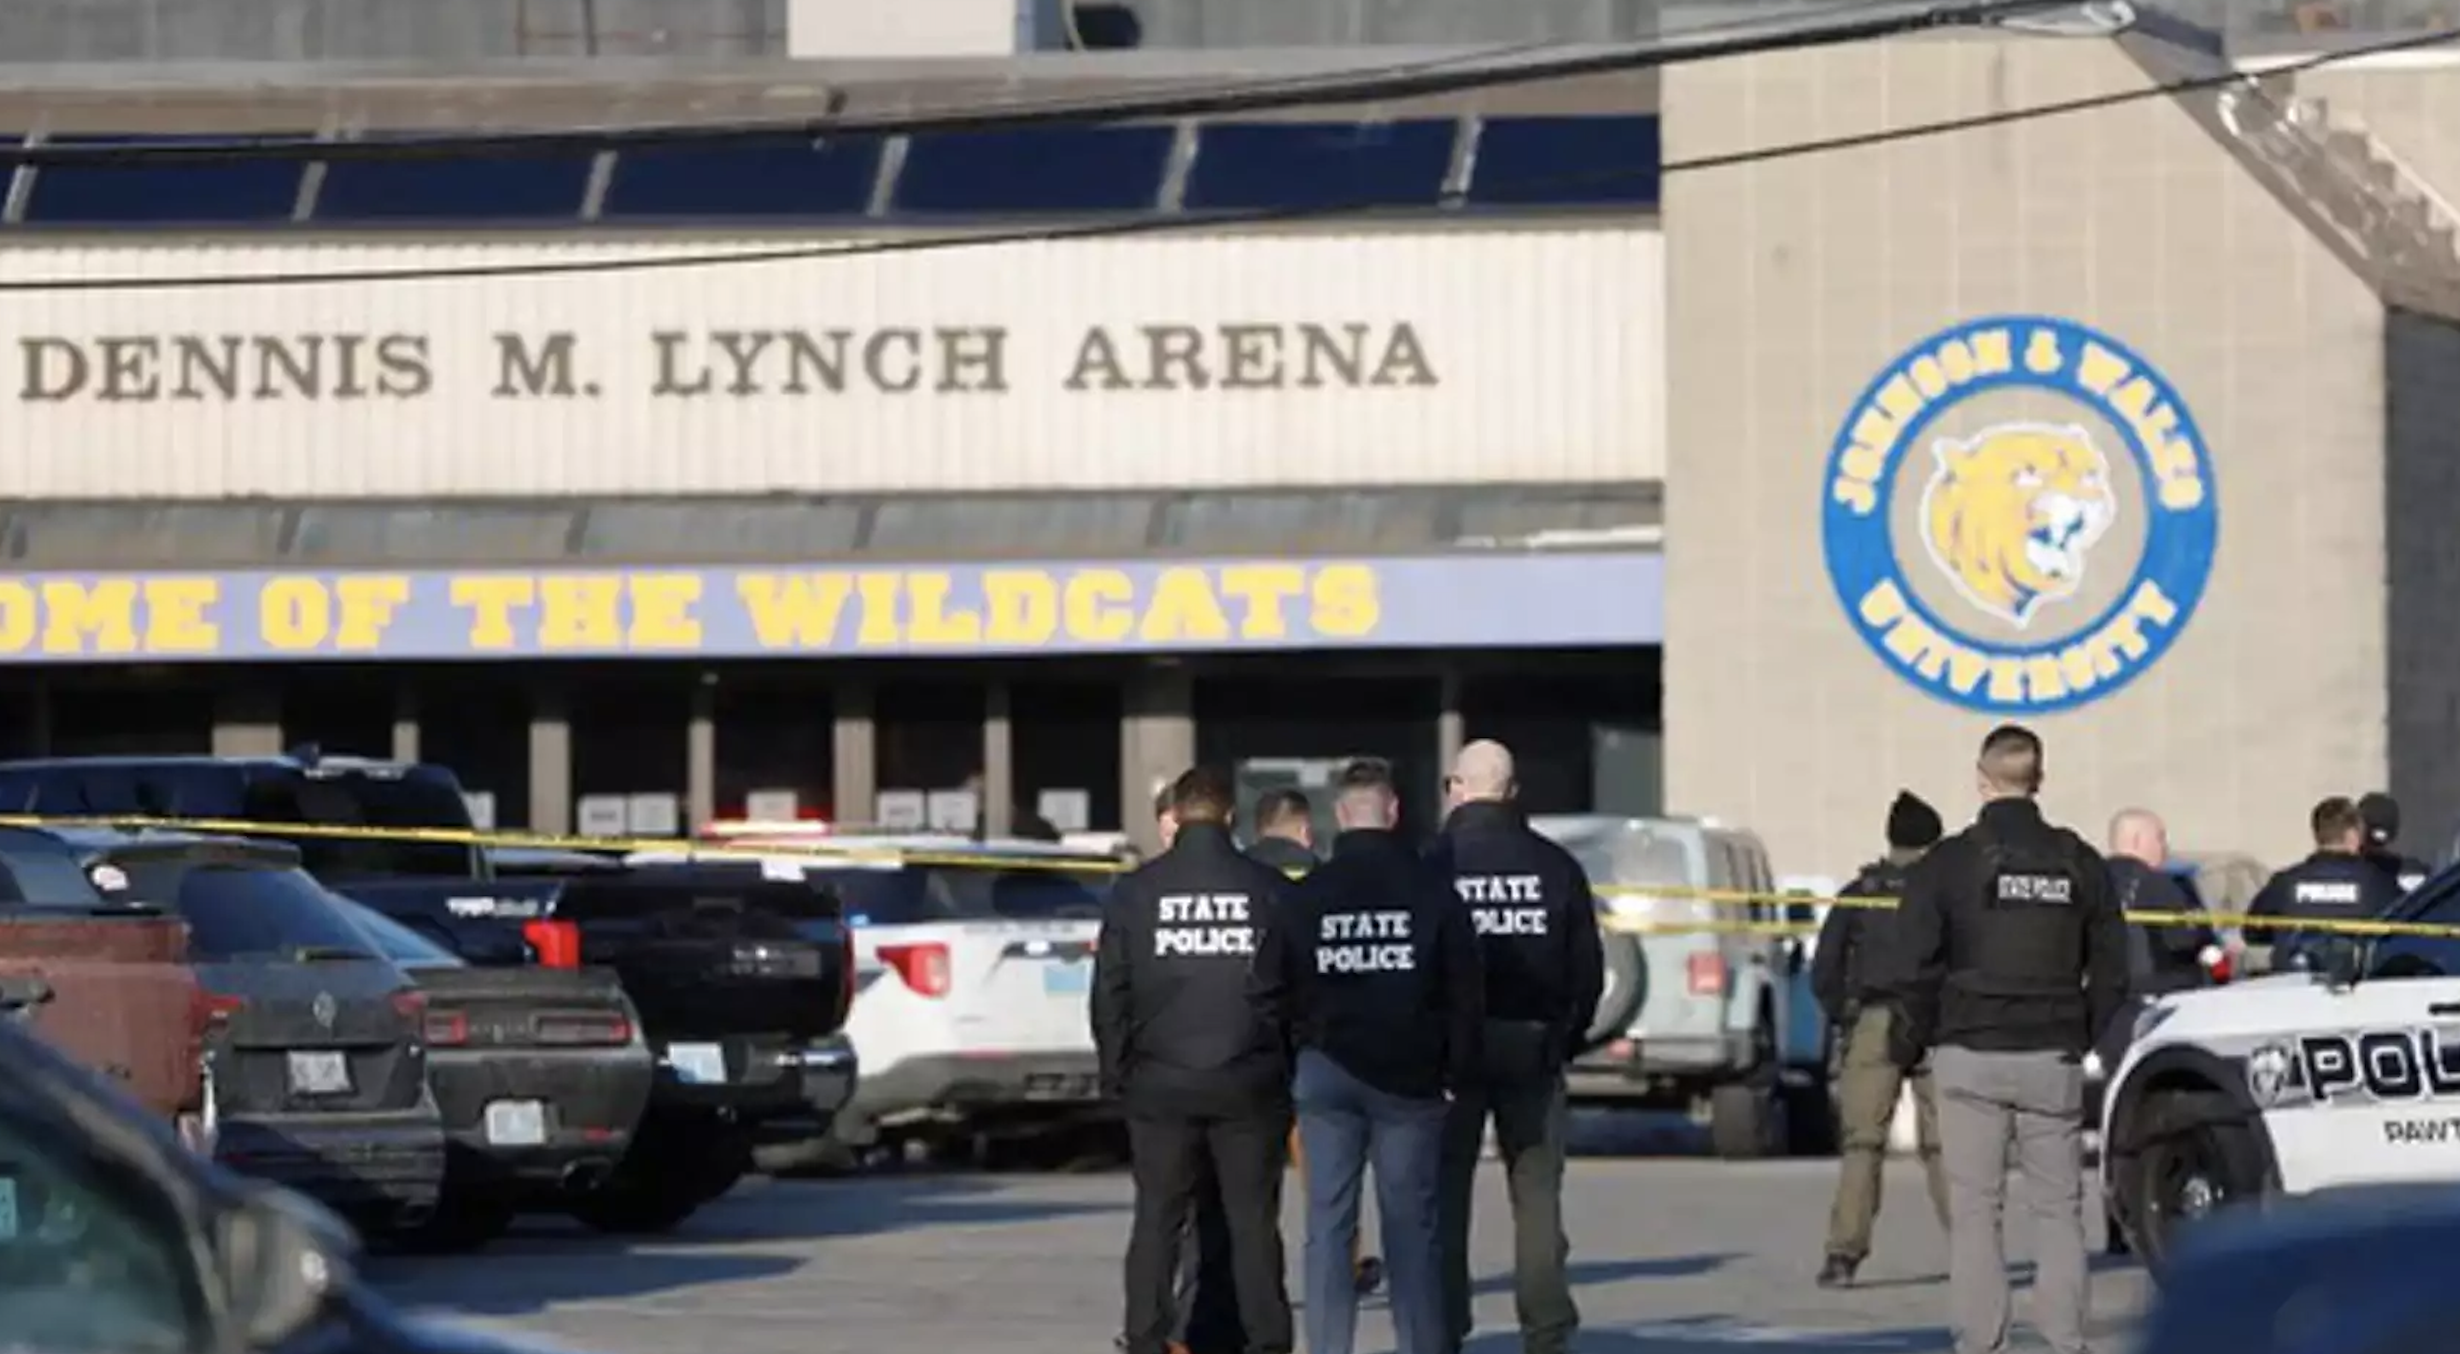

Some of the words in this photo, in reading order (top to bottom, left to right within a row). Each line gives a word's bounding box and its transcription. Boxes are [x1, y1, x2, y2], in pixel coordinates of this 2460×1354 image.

[17, 332, 432, 402] DENNIS
[492, 332, 603, 399] M.
[651, 326, 1010, 397] LYNCH
[1063, 320, 1439, 391] ARENA
[1832, 328, 2011, 515] JOHNSON
[2024, 328, 2062, 374] &
[2077, 340, 2204, 510] WALES
[260, 575, 409, 651] OF
[450, 572, 703, 649] THE
[736, 563, 1381, 648] WILDCATS
[1858, 578, 2176, 702] UNIVERSITY
[1158, 894, 1249, 922] STATE
[1320, 911, 1411, 940] STATE
[1470, 907, 1547, 936] OLICE
[1154, 927, 1254, 957] POLICE
[1316, 944, 1415, 974] POLICE
[2300, 1027, 2460, 1102] POL
